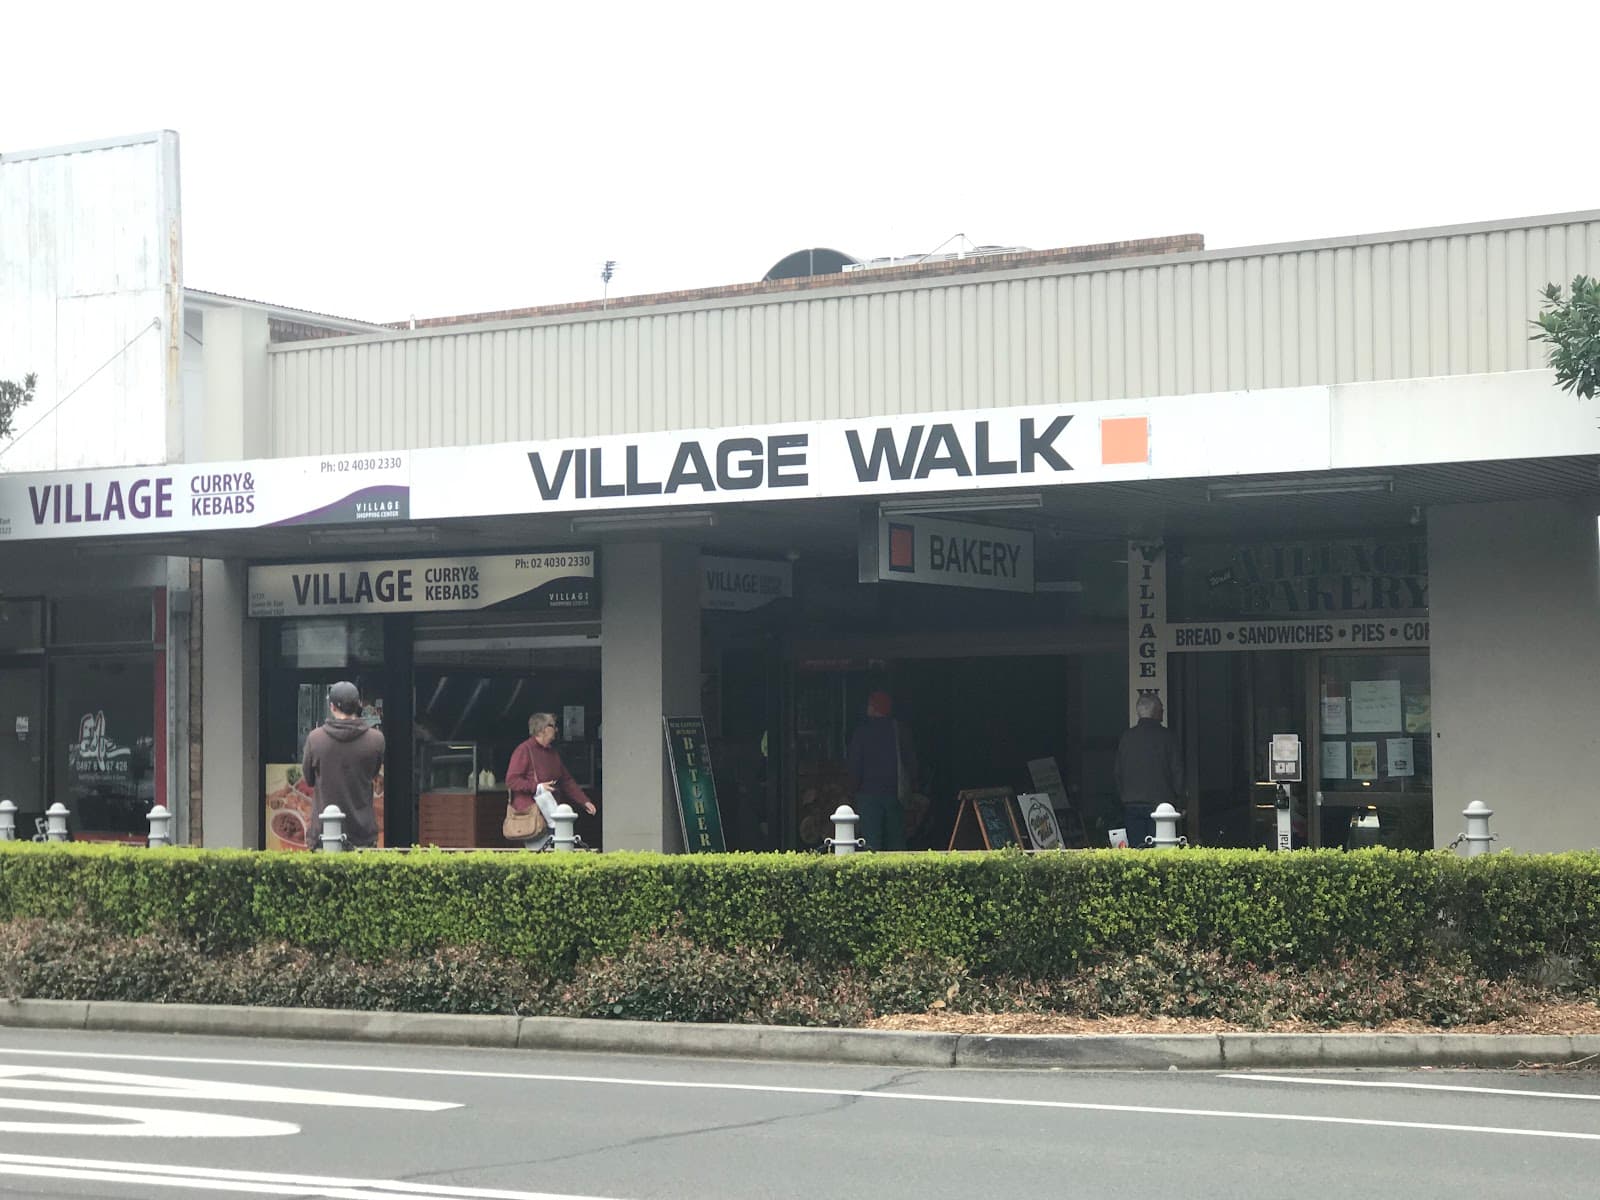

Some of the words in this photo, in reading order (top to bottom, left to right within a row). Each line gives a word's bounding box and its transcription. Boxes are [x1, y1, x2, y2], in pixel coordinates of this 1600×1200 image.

[320, 460, 336, 472] Ph:
[337, 460, 350, 472] 02
[352, 459, 376, 471] 4030
[377, 457, 402, 470] 2330
[527, 433, 809, 501] VILLAGE
[845, 414, 1075, 483] WALK
[190, 471, 255, 494] CURRY&
[28, 477, 173, 525] VILLAGE
[191, 494, 255, 516] KEBABS
[355, 501, 400, 512] VILLAGE
[515, 558, 529, 569] Ph:
[531, 558, 542, 569] 02
[544, 557, 566, 568] 4030
[567, 555, 590, 567] 2330
[930, 534, 1021, 578] BAKERY
[424, 565, 480, 583] CURRY&
[706, 569, 759, 593] VILLAGE
[292, 569, 413, 606] VILLAGE
[425, 583, 480, 601] KEBABS
[1175, 628, 1221, 646] BREAD
[1238, 624, 1334, 645] SANDWICHES
[1352, 623, 1385, 642] PIES
[682, 736, 712, 847] BUTCHER
